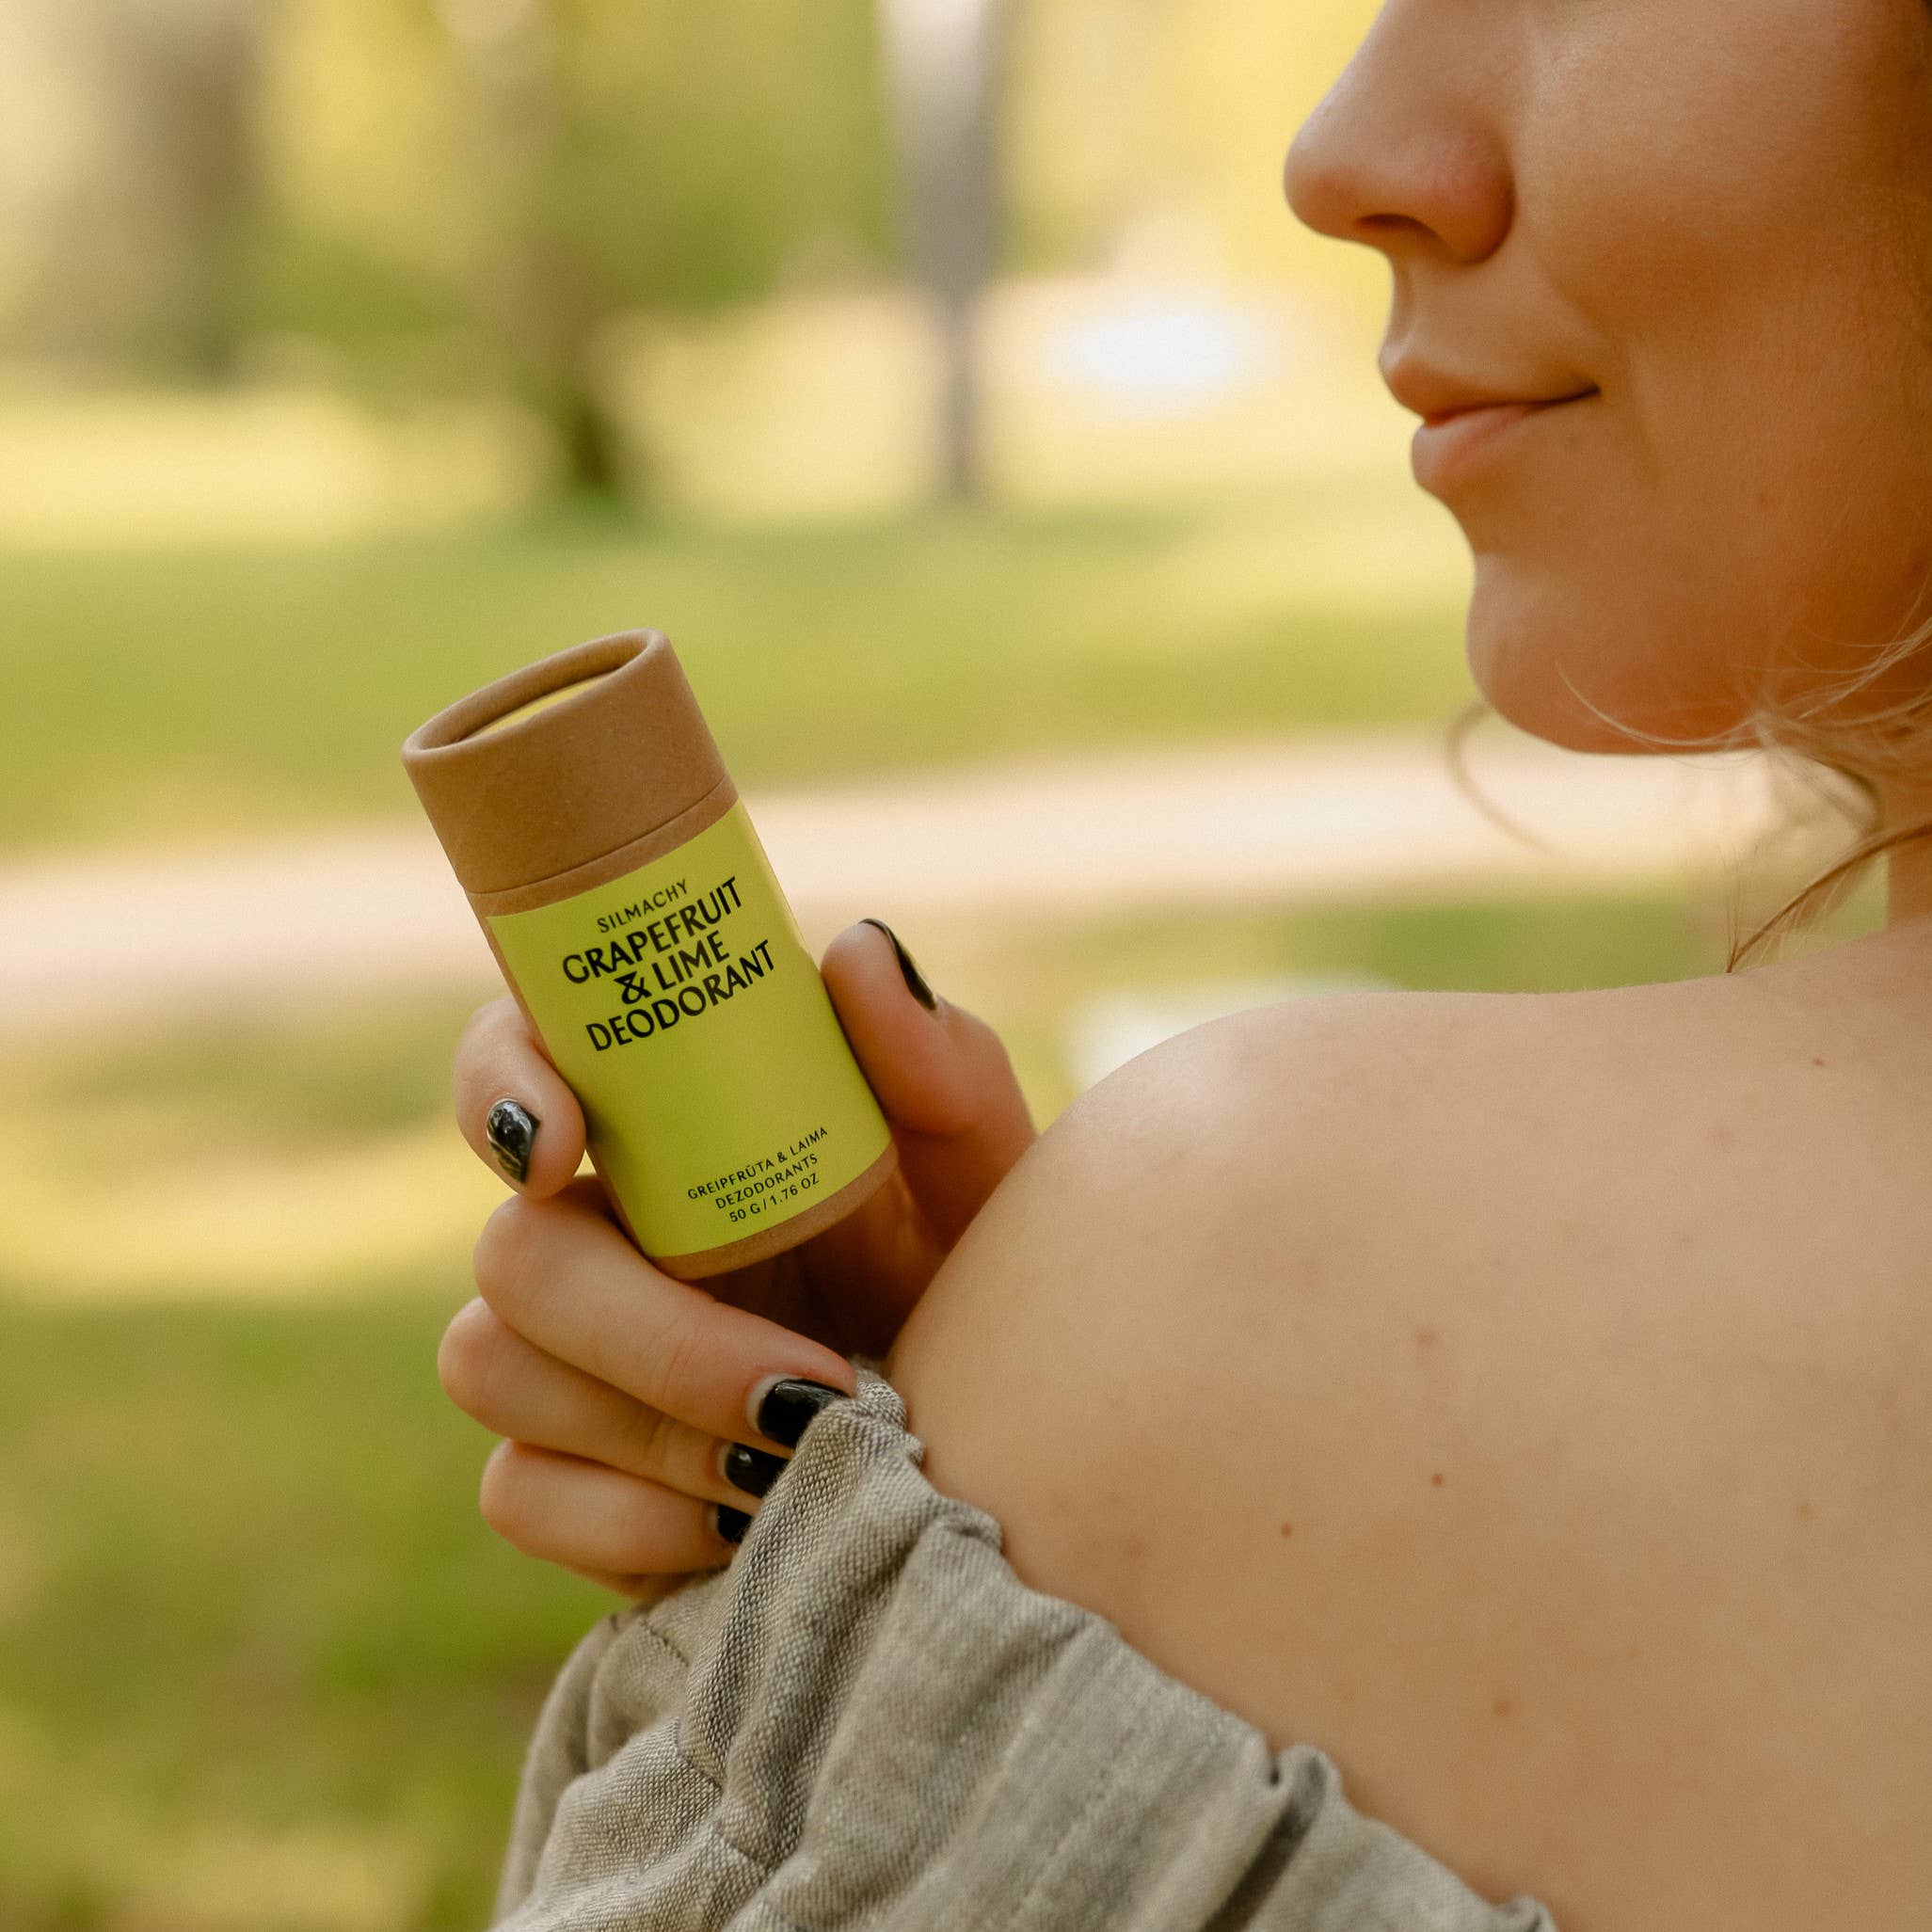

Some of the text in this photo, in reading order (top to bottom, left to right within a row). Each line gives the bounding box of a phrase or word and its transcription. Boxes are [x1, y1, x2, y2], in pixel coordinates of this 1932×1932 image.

[563, 876, 742, 983] GRAPEFRUIT
[598, 879, 688, 933] SILMACHY
[585, 939, 774, 1051] DEODORANT
[614, 930, 729, 1004] & LIME
[688, 1126, 828, 1199] GREIPFRŪTA & LAIMA
[715, 1153, 818, 1209] DEZODORANTS
[729, 1209, 746, 1222] 50
[801, 1173, 820, 1190] OZ
